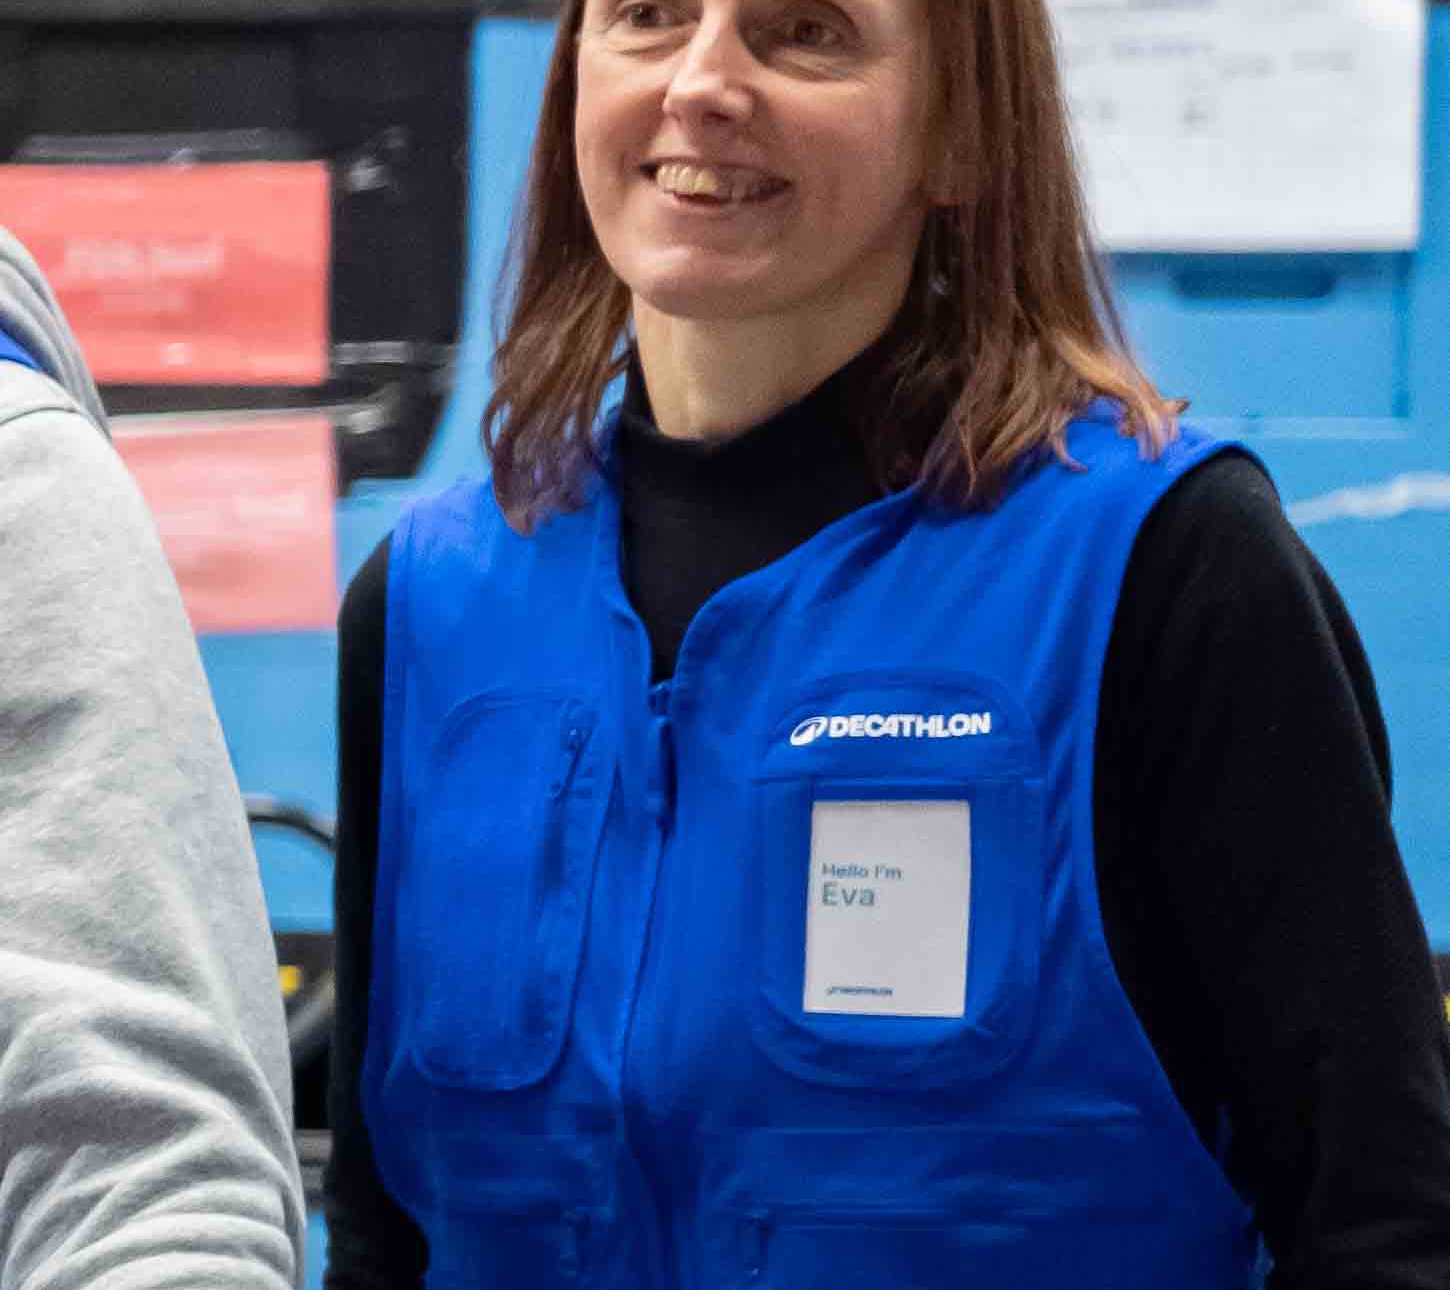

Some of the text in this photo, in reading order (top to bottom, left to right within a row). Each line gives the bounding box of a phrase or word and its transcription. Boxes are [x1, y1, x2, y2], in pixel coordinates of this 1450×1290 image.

[828, 712, 991, 739] DECATHLON
[822, 862, 902, 880] Hello I'm
[822, 881, 876, 907] Eva
